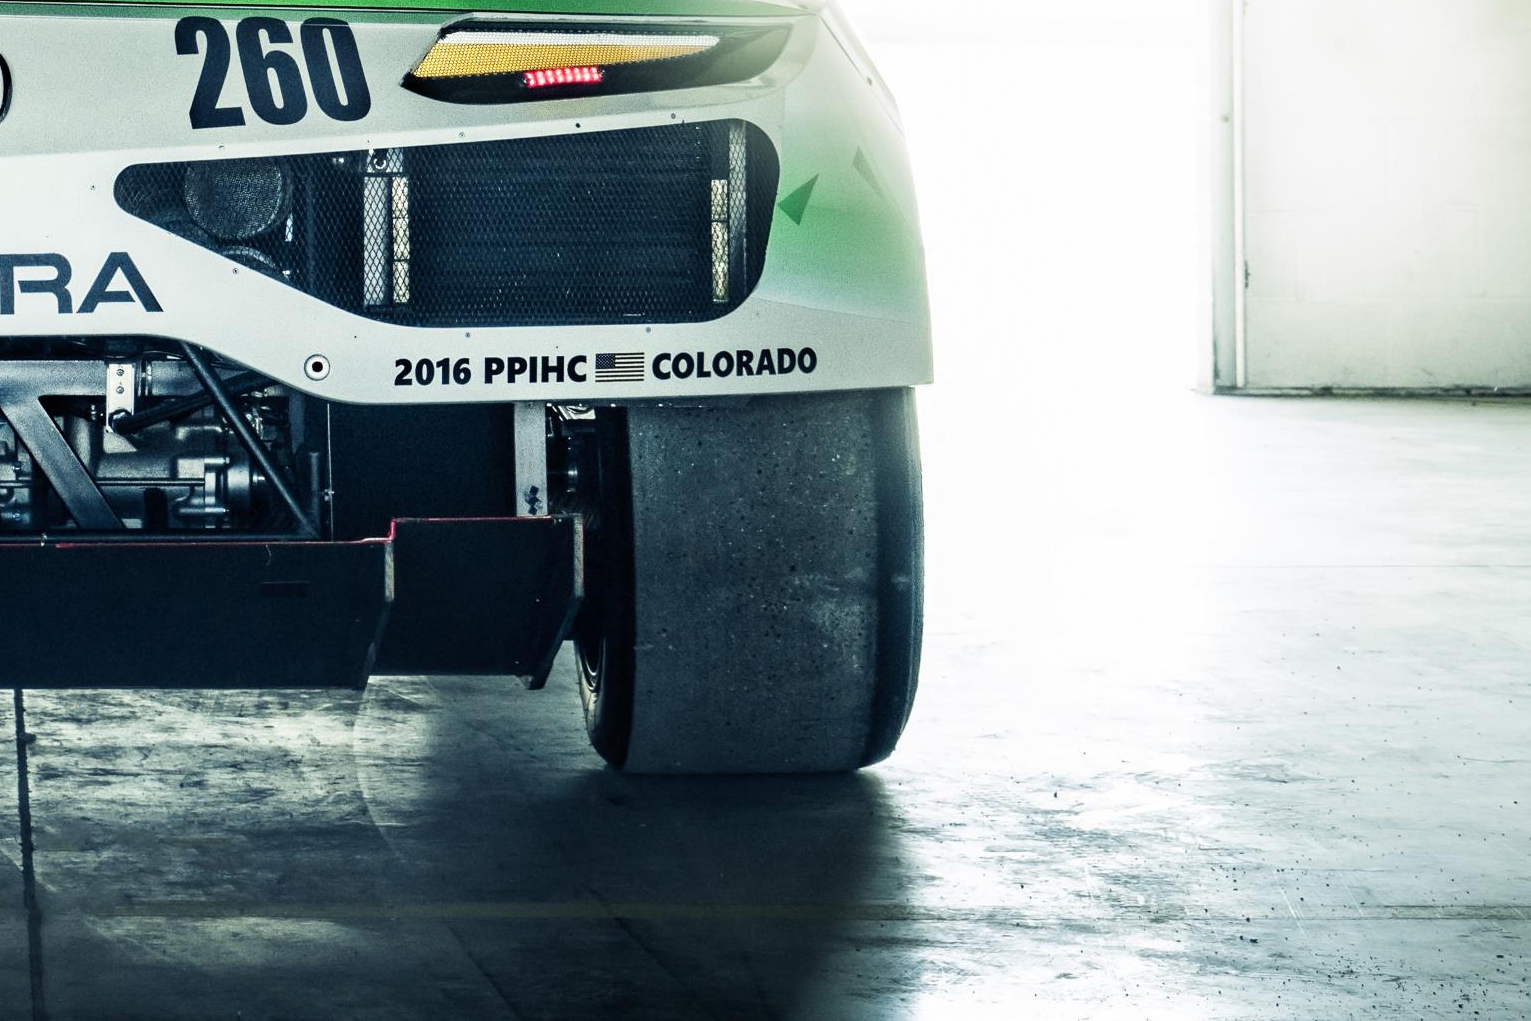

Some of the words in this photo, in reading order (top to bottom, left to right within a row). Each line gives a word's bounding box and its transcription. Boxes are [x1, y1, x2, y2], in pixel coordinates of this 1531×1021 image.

[175, 16, 371, 129] 260
[394, 357, 472, 387] 2016
[484, 354, 587, 385] PPIHC
[651, 346, 818, 381] COLORADO
